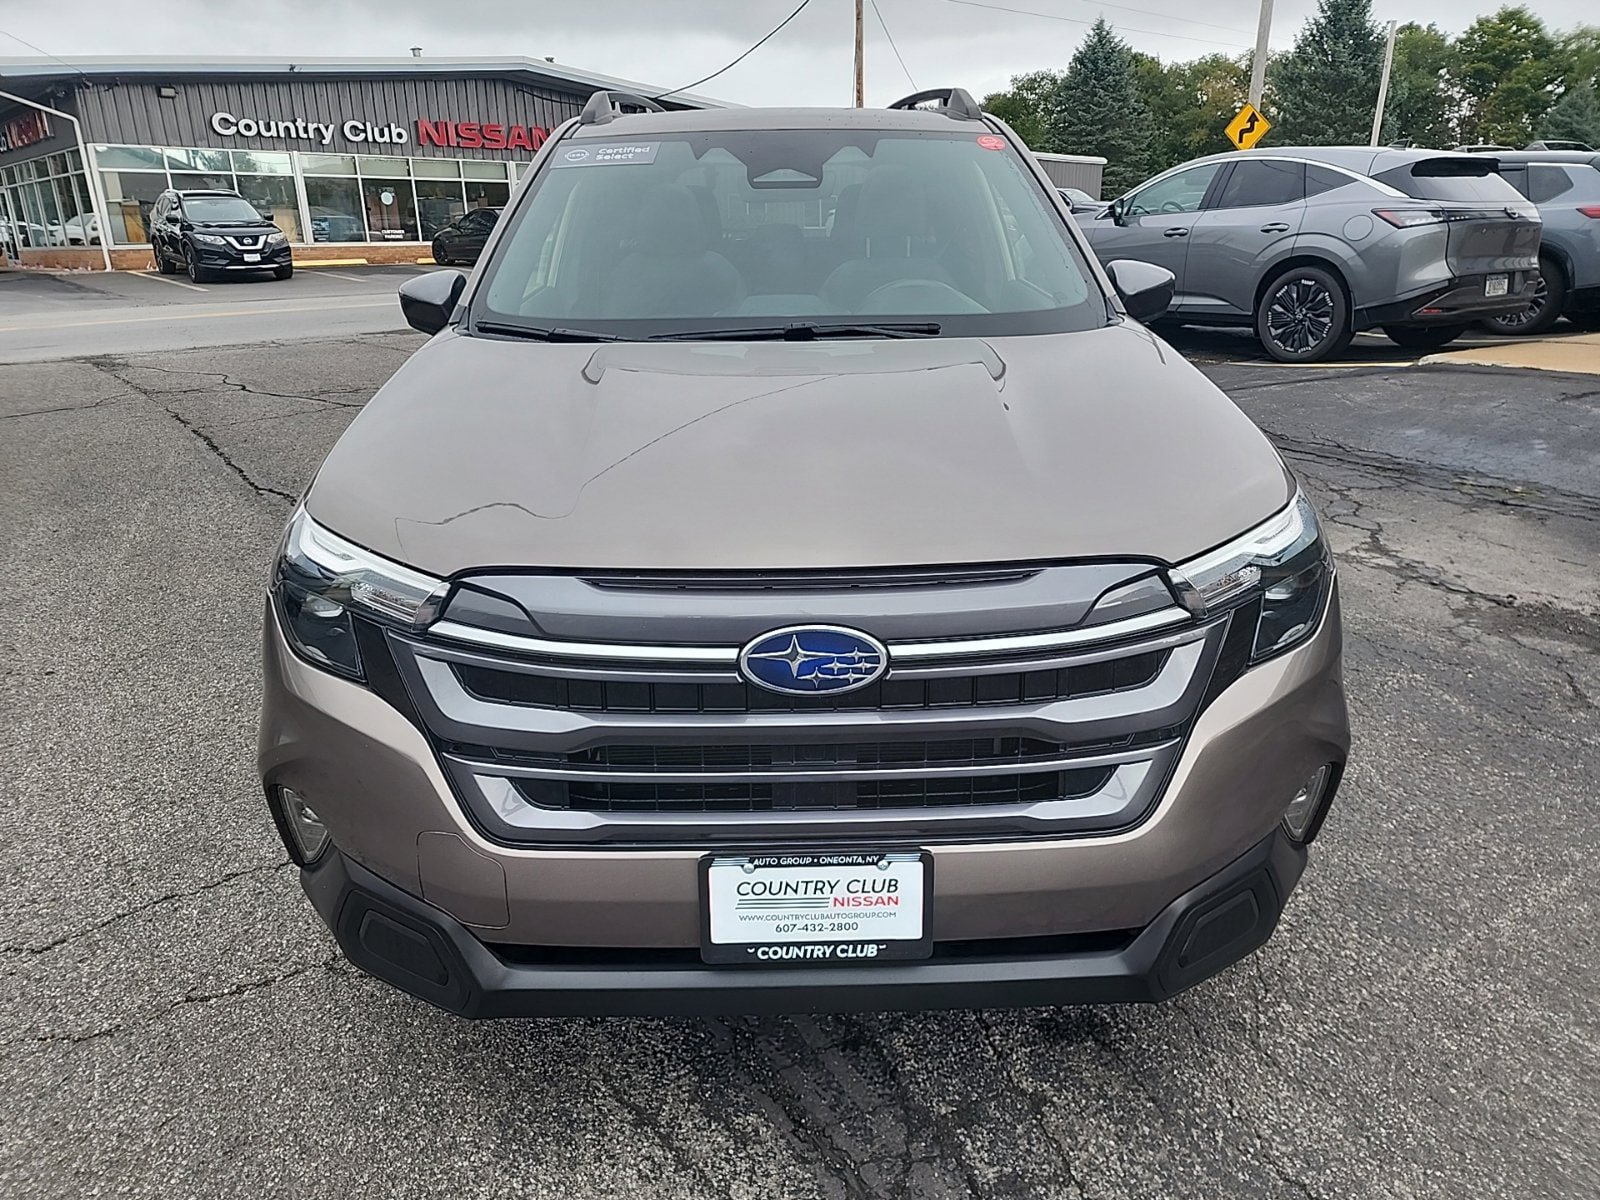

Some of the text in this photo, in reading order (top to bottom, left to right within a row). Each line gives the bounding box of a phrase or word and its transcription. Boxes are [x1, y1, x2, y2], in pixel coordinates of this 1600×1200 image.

[211, 112, 335, 145] Country
[343, 120, 408, 144] Club
[598, 146, 651, 154] Certified
[595, 153, 634, 161] Select
[753, 857, 778, 866] AUTO
[780, 856, 812, 865] GROUP
[736, 878, 899, 896] COUNTRY CLUB
[833, 896, 899, 908] NISSAN
[739, 912, 897, 922] WWW.COUNTRYCLUBAUTOGROUP.COM
[775, 922, 859, 933] 607-432-2800
[757, 943, 878, 960] COUNTRY CLUB
